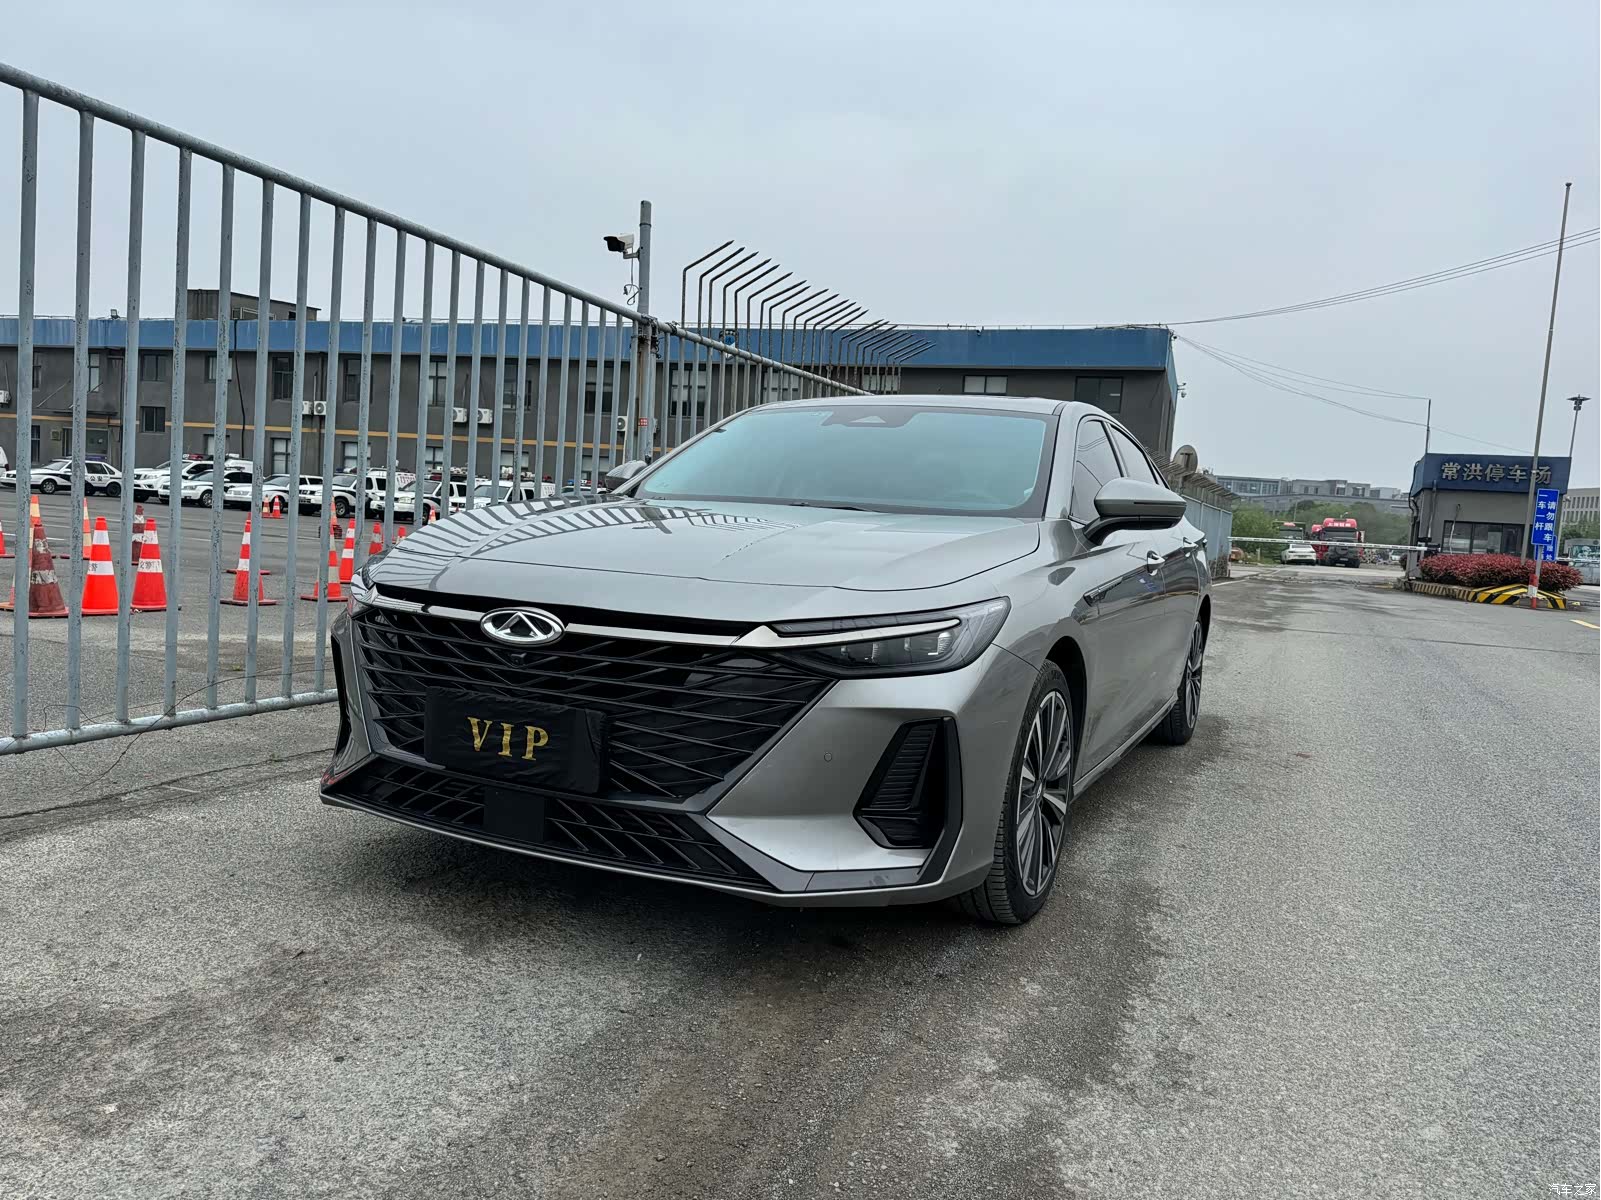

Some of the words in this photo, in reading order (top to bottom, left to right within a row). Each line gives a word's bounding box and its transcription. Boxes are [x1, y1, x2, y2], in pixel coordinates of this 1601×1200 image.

[1441, 461, 1552, 484] 常洪停车场
[1534, 493, 1548, 531] 一车一杆
[1543, 500, 1557, 543] 请勿跟车
[466, 716, 550, 761] VIP
